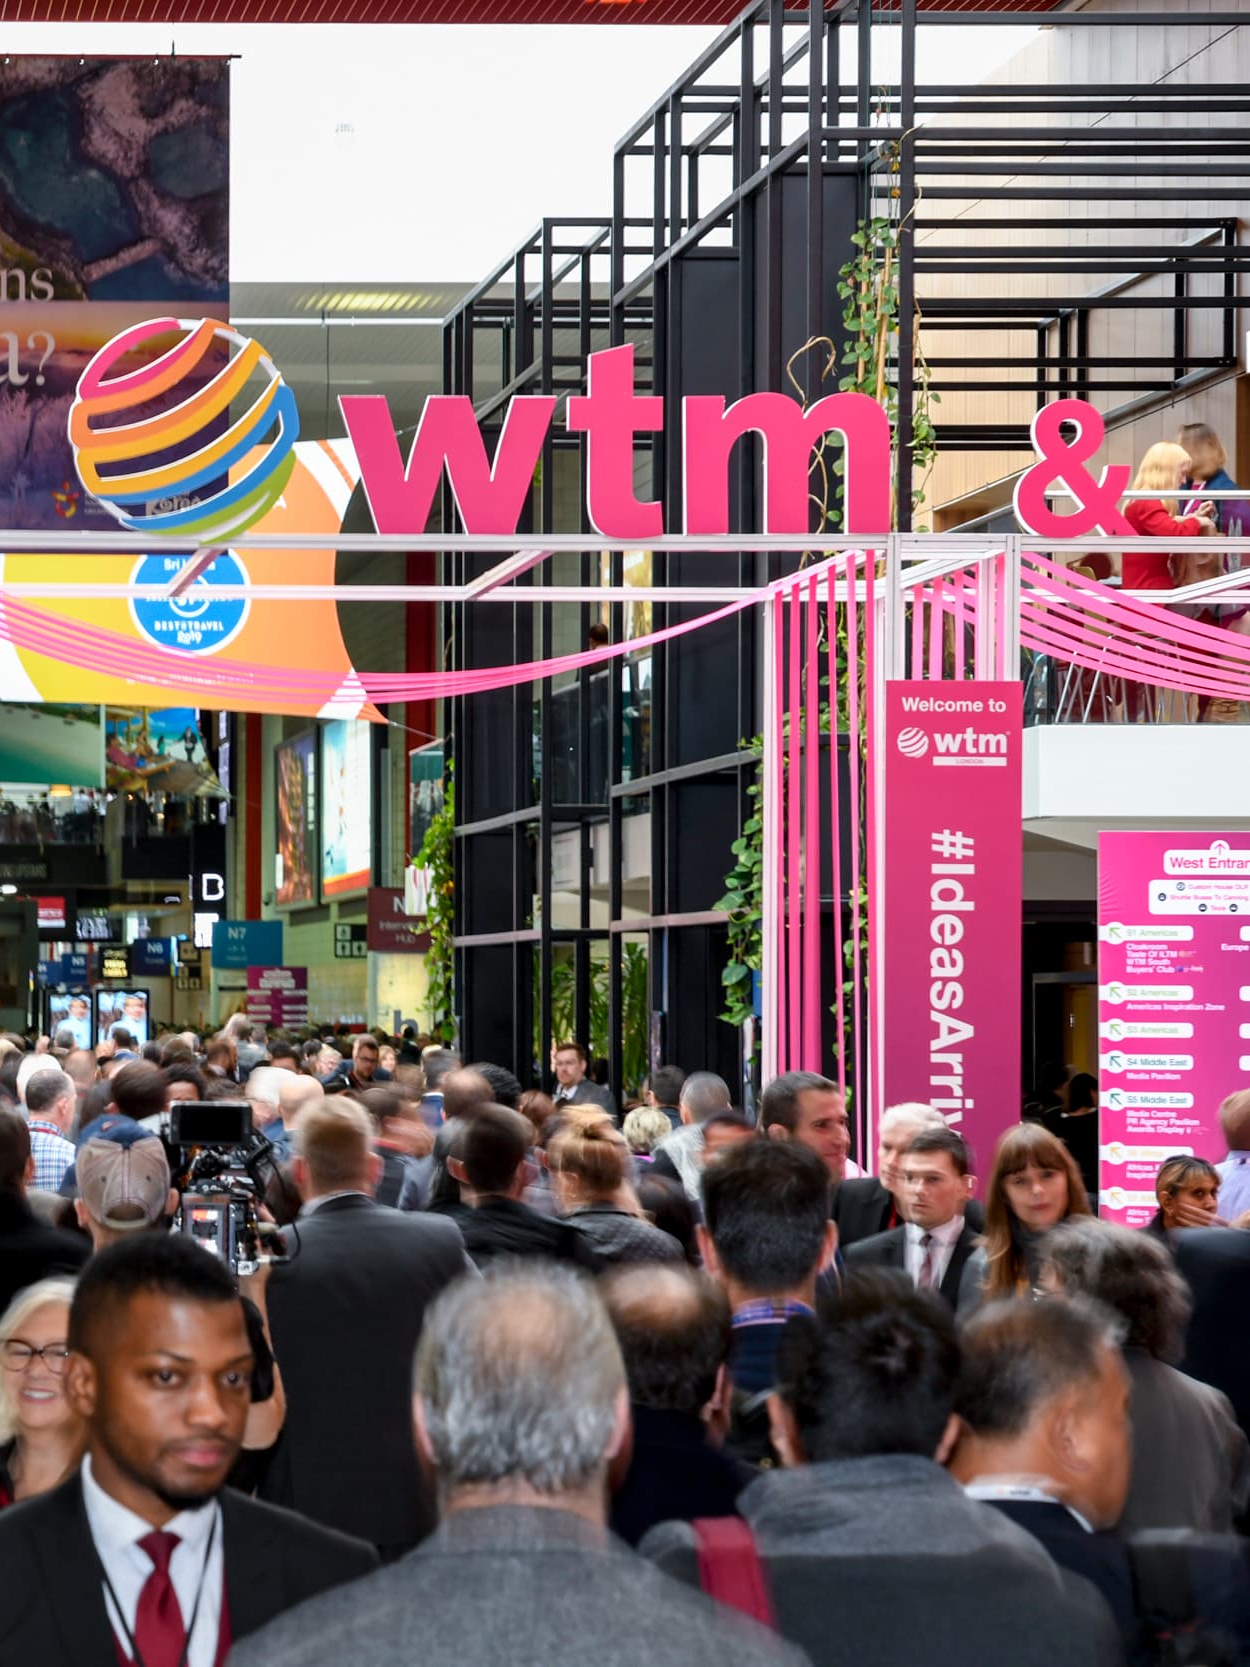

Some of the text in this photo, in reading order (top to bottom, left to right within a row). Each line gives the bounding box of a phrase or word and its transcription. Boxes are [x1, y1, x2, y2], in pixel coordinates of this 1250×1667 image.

[338, 342, 893, 540] wtm
[1012, 399, 1131, 538] &
[901, 696, 1007, 713] Welcome to
[933, 726, 1008, 754] wtm
[1169, 856, 1204, 869] West
[227, 926, 247, 940] N7
[1140, 929, 1179, 937] Americas
[1140, 988, 1179, 997] Americas
[1140, 1025, 1179, 1034] Americas
[1140, 1057, 1167, 1066] Middle
[1169, 1057, 1188, 1066] East
[1140, 1095, 1167, 1104] Middle
[1169, 1095, 1188, 1104] East
